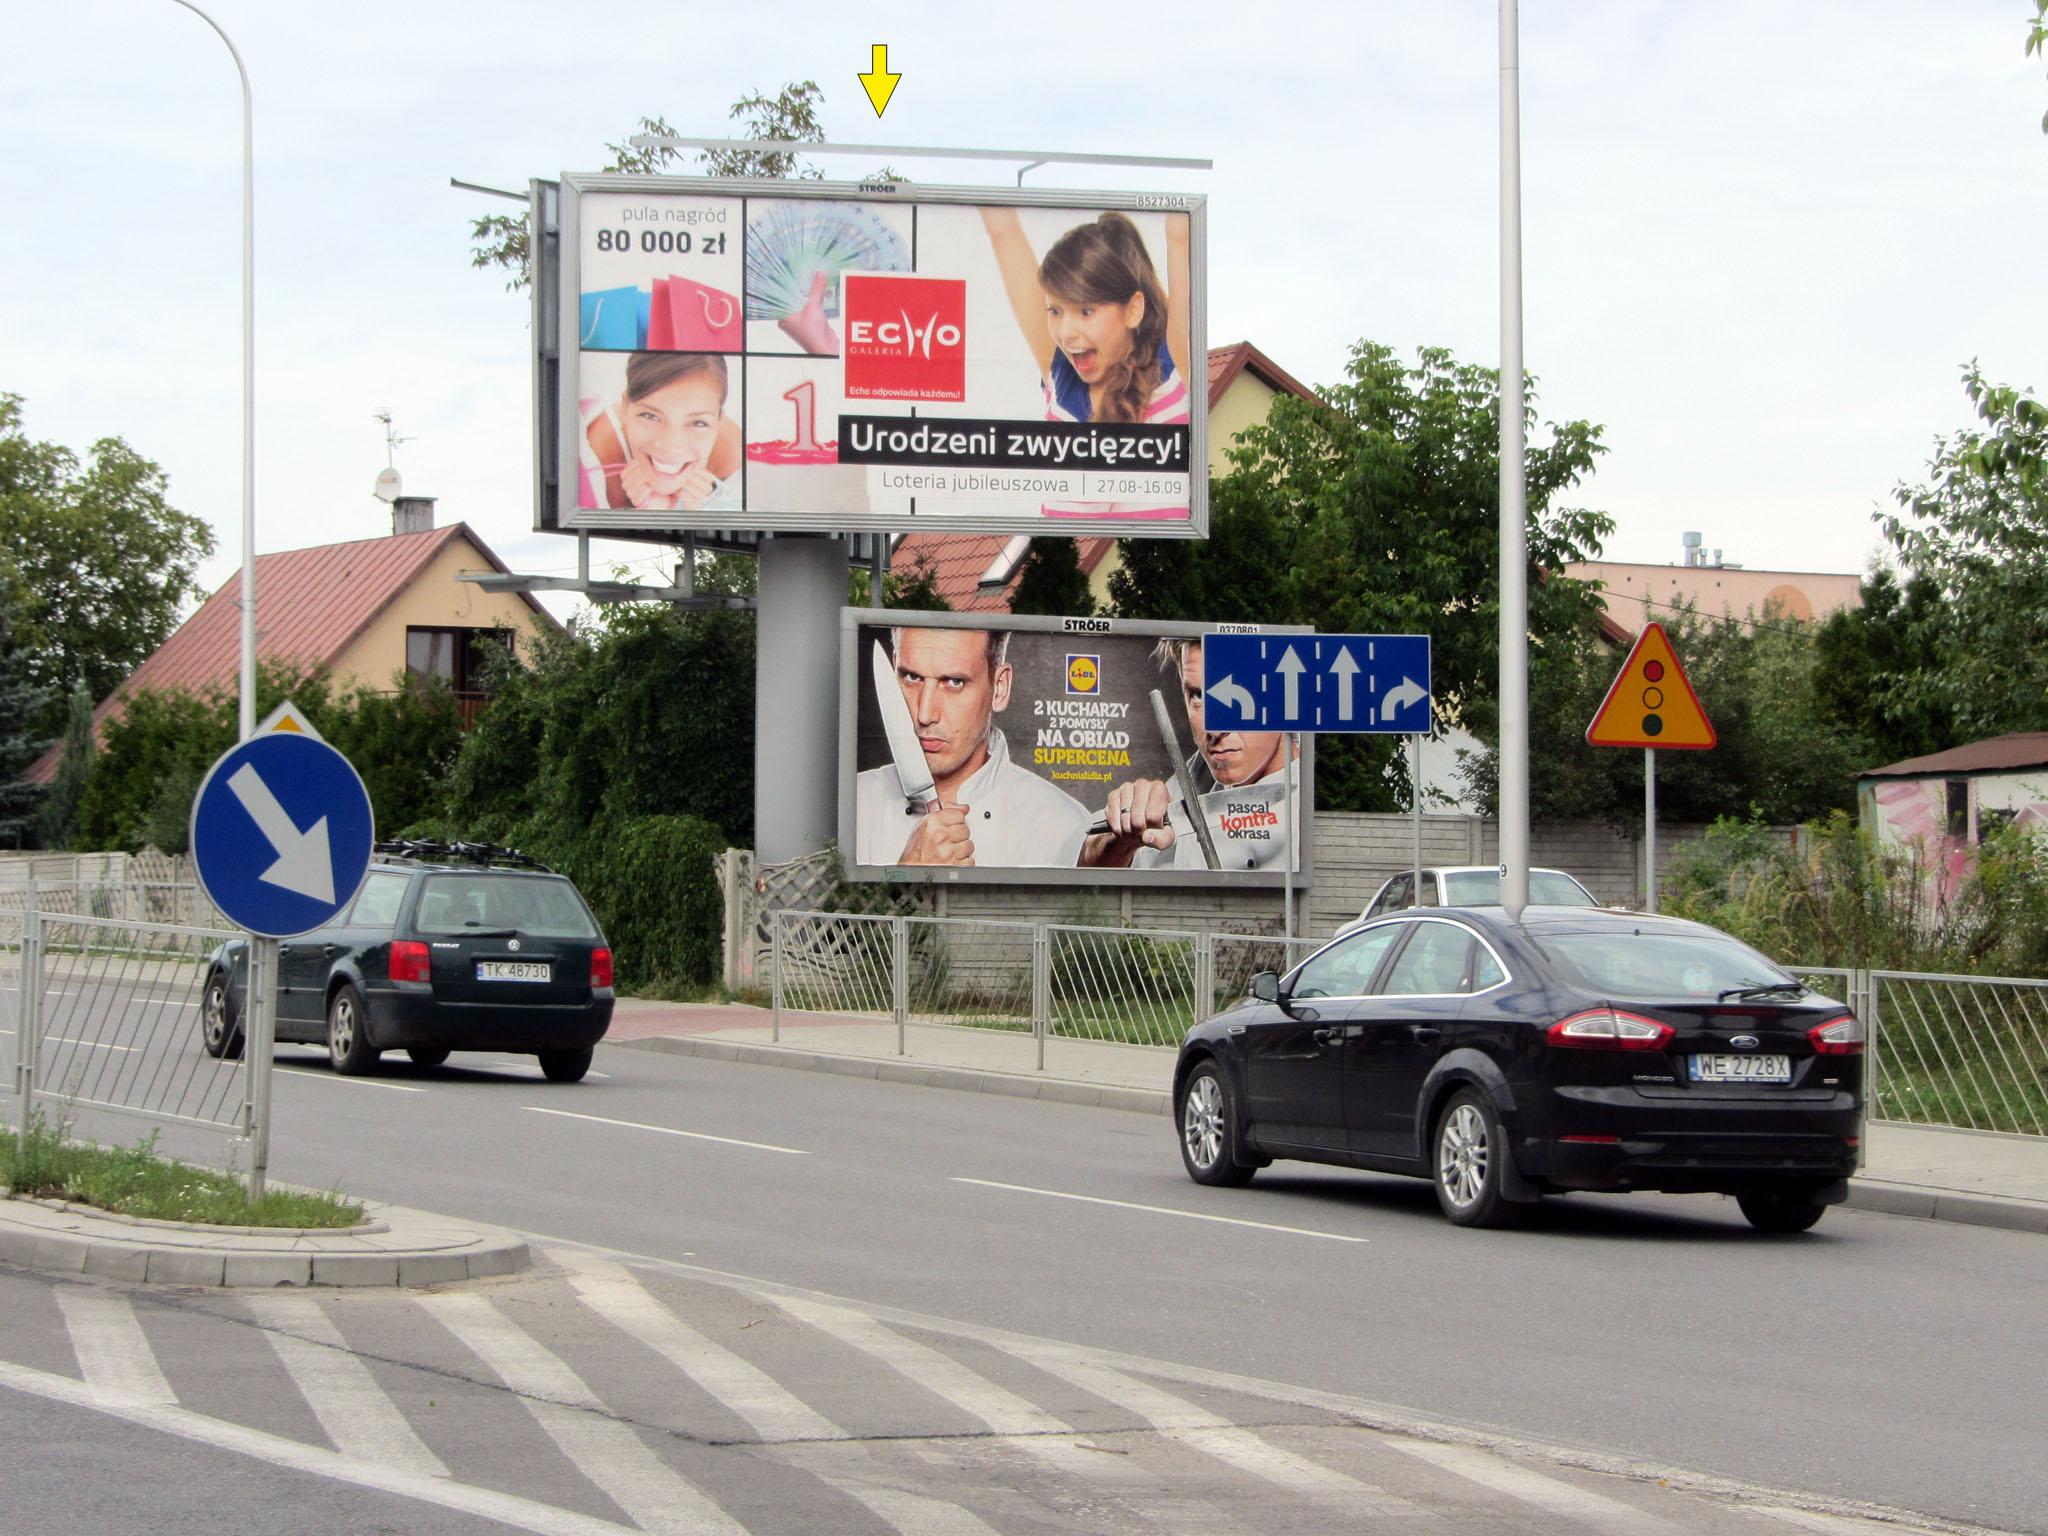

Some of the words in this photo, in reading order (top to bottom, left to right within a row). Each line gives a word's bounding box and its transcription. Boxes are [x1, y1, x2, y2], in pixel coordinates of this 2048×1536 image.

[1137, 196, 1184, 207] 8527304
[623, 206, 659, 223] pula
[665, 208, 726, 225] nagród
[597, 229, 631, 252] 80
[641, 231, 692, 253] 000
[702, 232, 727, 255] zł
[851, 308, 961, 361] ECHO
[850, 346, 902, 356] GALERIA
[849, 386, 870, 396] Echo
[872, 387, 919, 398] odpowiada
[920, 389, 961, 399] każdemu!
[850, 423, 997, 455] Urodzeni
[1007, 430, 1182, 465] zwycięzcy!
[882, 471, 946, 489] Loteria
[952, 474, 1069, 493] jubileuszowa
[1097, 480, 1182, 495] 27.08-16.09
[1064, 618, 1111, 632] STRÖER
[1034, 700, 1044, 716] 2
[1045, 700, 1130, 718] KUCHARZY
[1049, 717, 1057, 728] 2
[1058, 717, 1110, 730] POMYSŁY
[1036, 729, 1066, 747] NA
[1068, 730, 1130, 749] OBIAD
[1034, 748, 1131, 767] SUPERCENA
[1051, 770, 1112, 782] kuchnialidla.pl
[1227, 801, 1270, 817] pascal
[1219, 811, 1279, 832] kontra
[1227, 829, 1271, 840] okrasa
[1499, 863, 1507, 878] 9
[485, 963, 504, 977] TK
[508, 964, 549, 979] 48730
[1701, 1055, 1727, 1075] WE
[1732, 1056, 1788, 1076] 2728X
